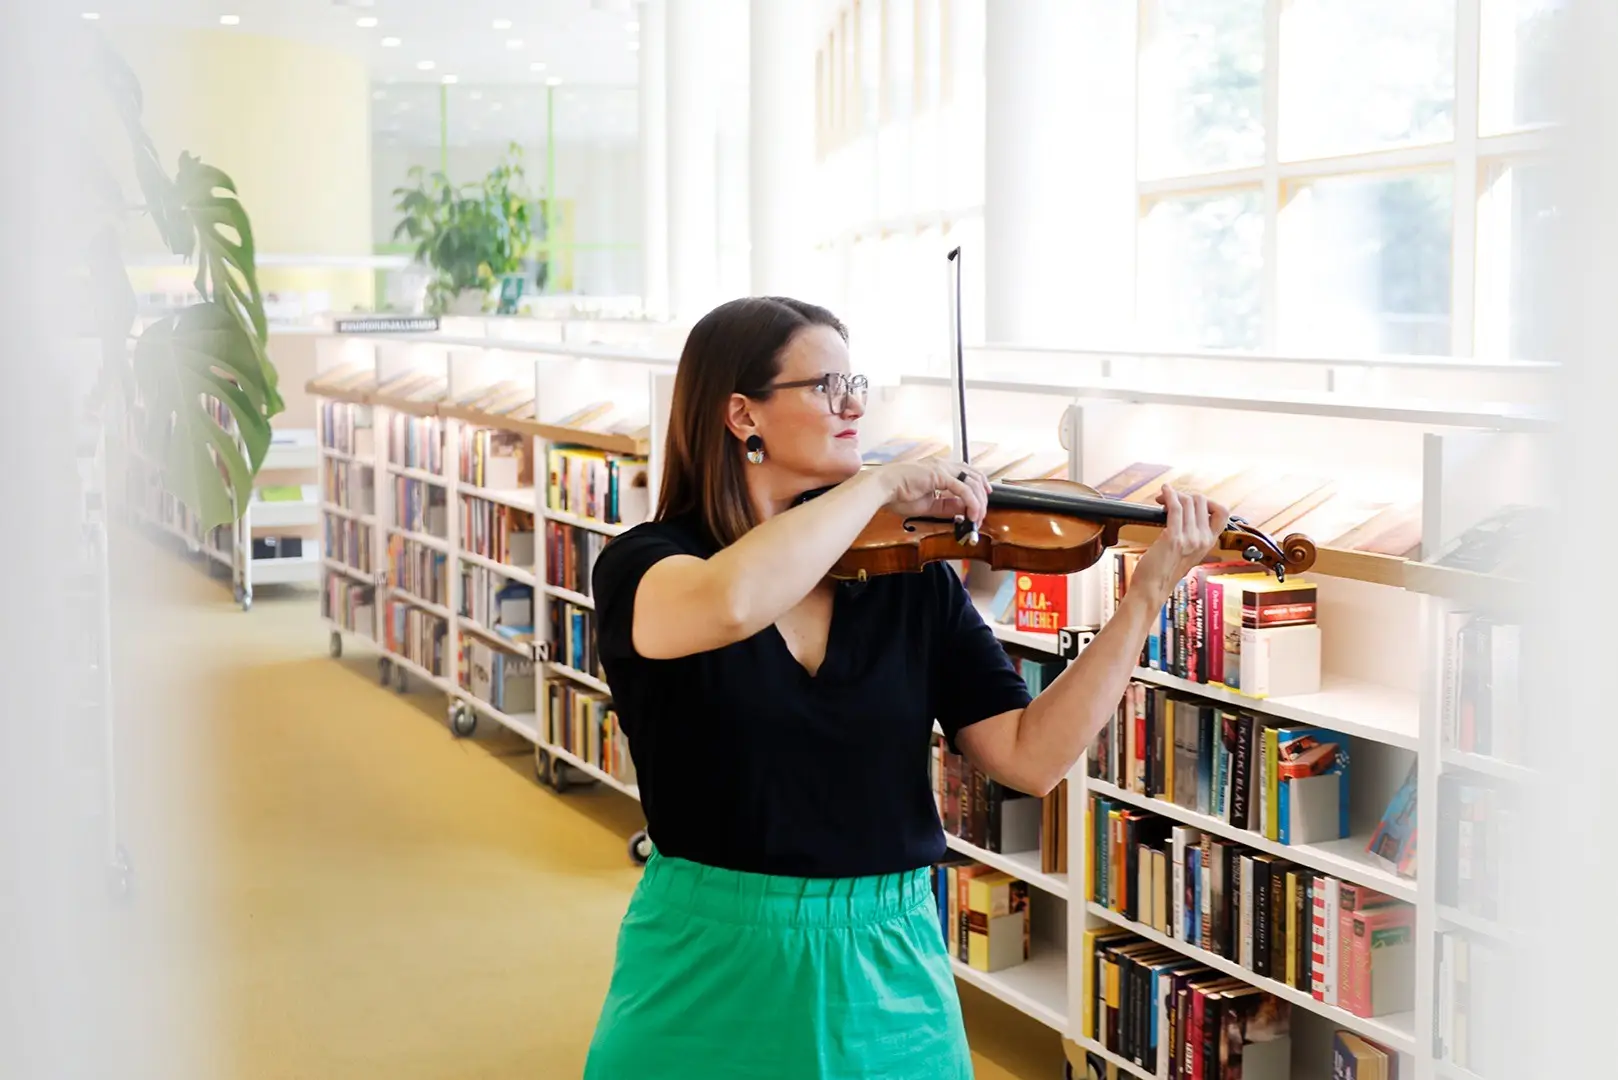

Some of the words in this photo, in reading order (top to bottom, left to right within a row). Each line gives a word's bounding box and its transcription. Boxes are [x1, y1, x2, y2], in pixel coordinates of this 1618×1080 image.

[1018, 590, 1051, 610] KALA-
[1018, 610, 1059, 630] MIEHET
[535, 644, 549, 661] N
[1059, 630, 1072, 656] P
[1236, 726, 1247, 775] KAIKKI
[1234, 778, 1245, 818] ELÄVÄ
